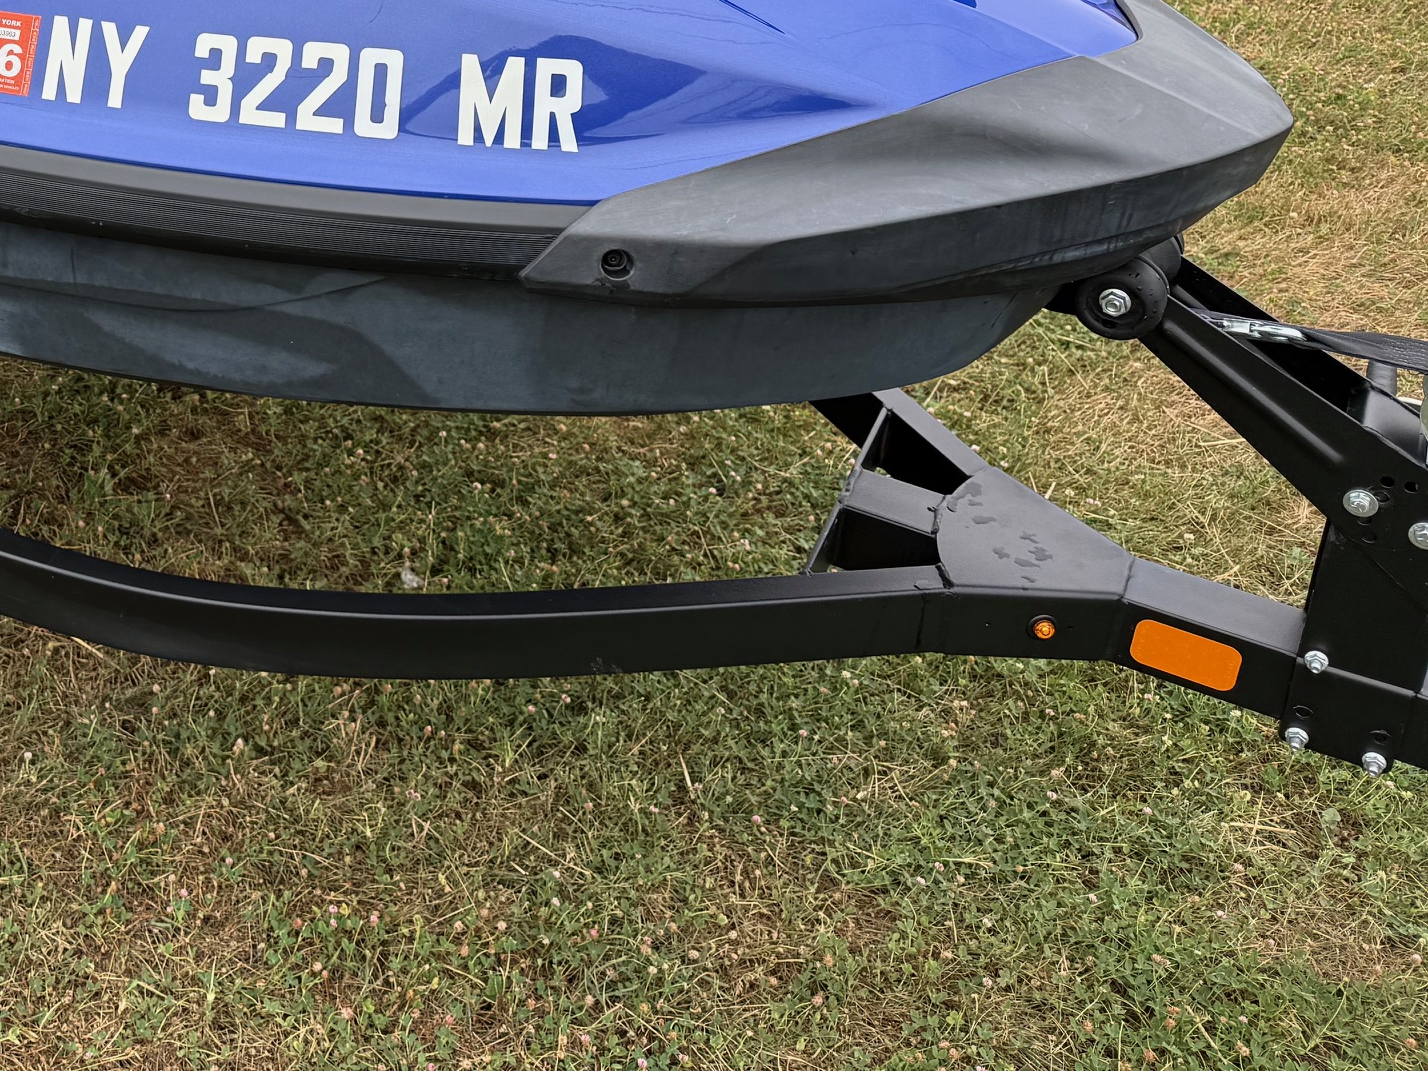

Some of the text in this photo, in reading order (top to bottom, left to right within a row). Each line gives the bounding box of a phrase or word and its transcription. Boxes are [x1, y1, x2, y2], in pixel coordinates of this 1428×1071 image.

[2, 18, 22, 27] YORK
[41, 14, 584, 153] NY 3220 MR
